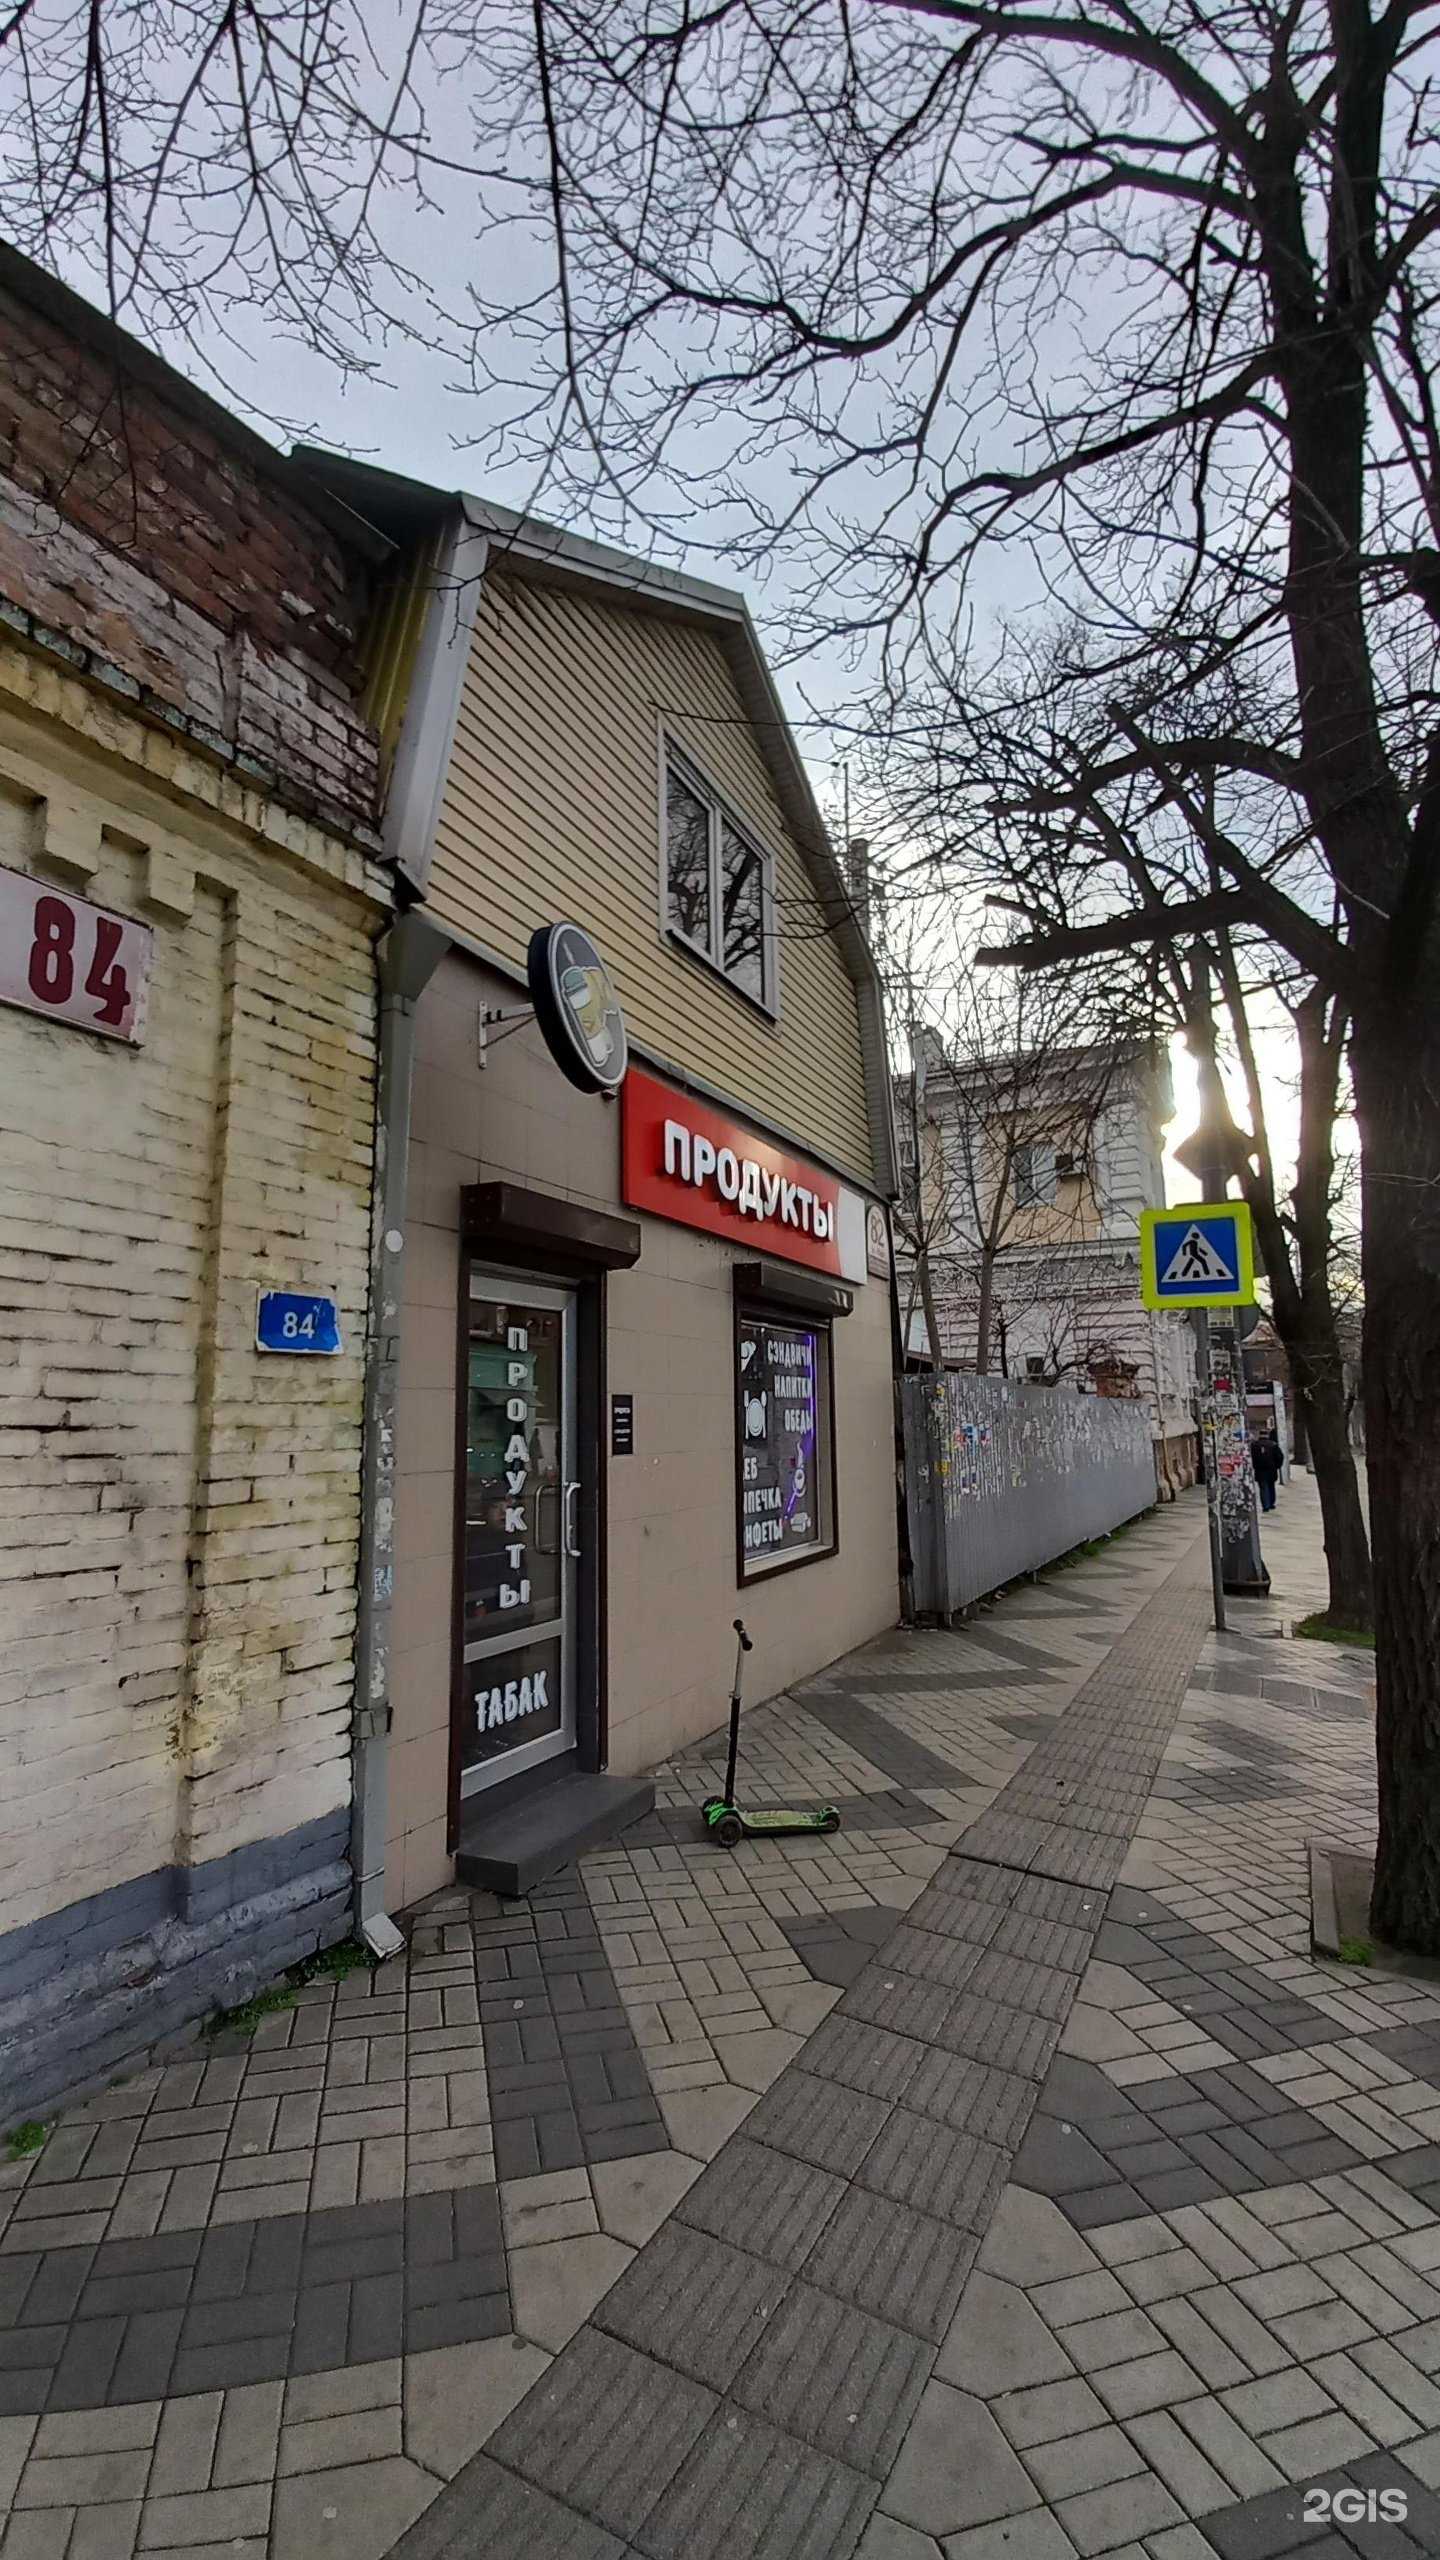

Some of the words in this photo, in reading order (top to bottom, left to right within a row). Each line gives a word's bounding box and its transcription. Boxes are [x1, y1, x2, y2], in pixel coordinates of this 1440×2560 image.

[28, 896, 131, 1026] 84
[664, 1119, 834, 1242] ПРОДУКТЫ
[283, 1311, 315, 1339] 84
[767, 1340, 812, 1368] СЭНДВИЧИ
[774, 1375, 812, 1399] НАПИТКИ
[785, 1409, 813, 1435] ОБЕДЫ
[499, 1326, 531, 1609] ПРОДУКТЫ
[743, 1457, 758, 1480] ЕБ
[474, 1670, 549, 1733] ТАБАК
